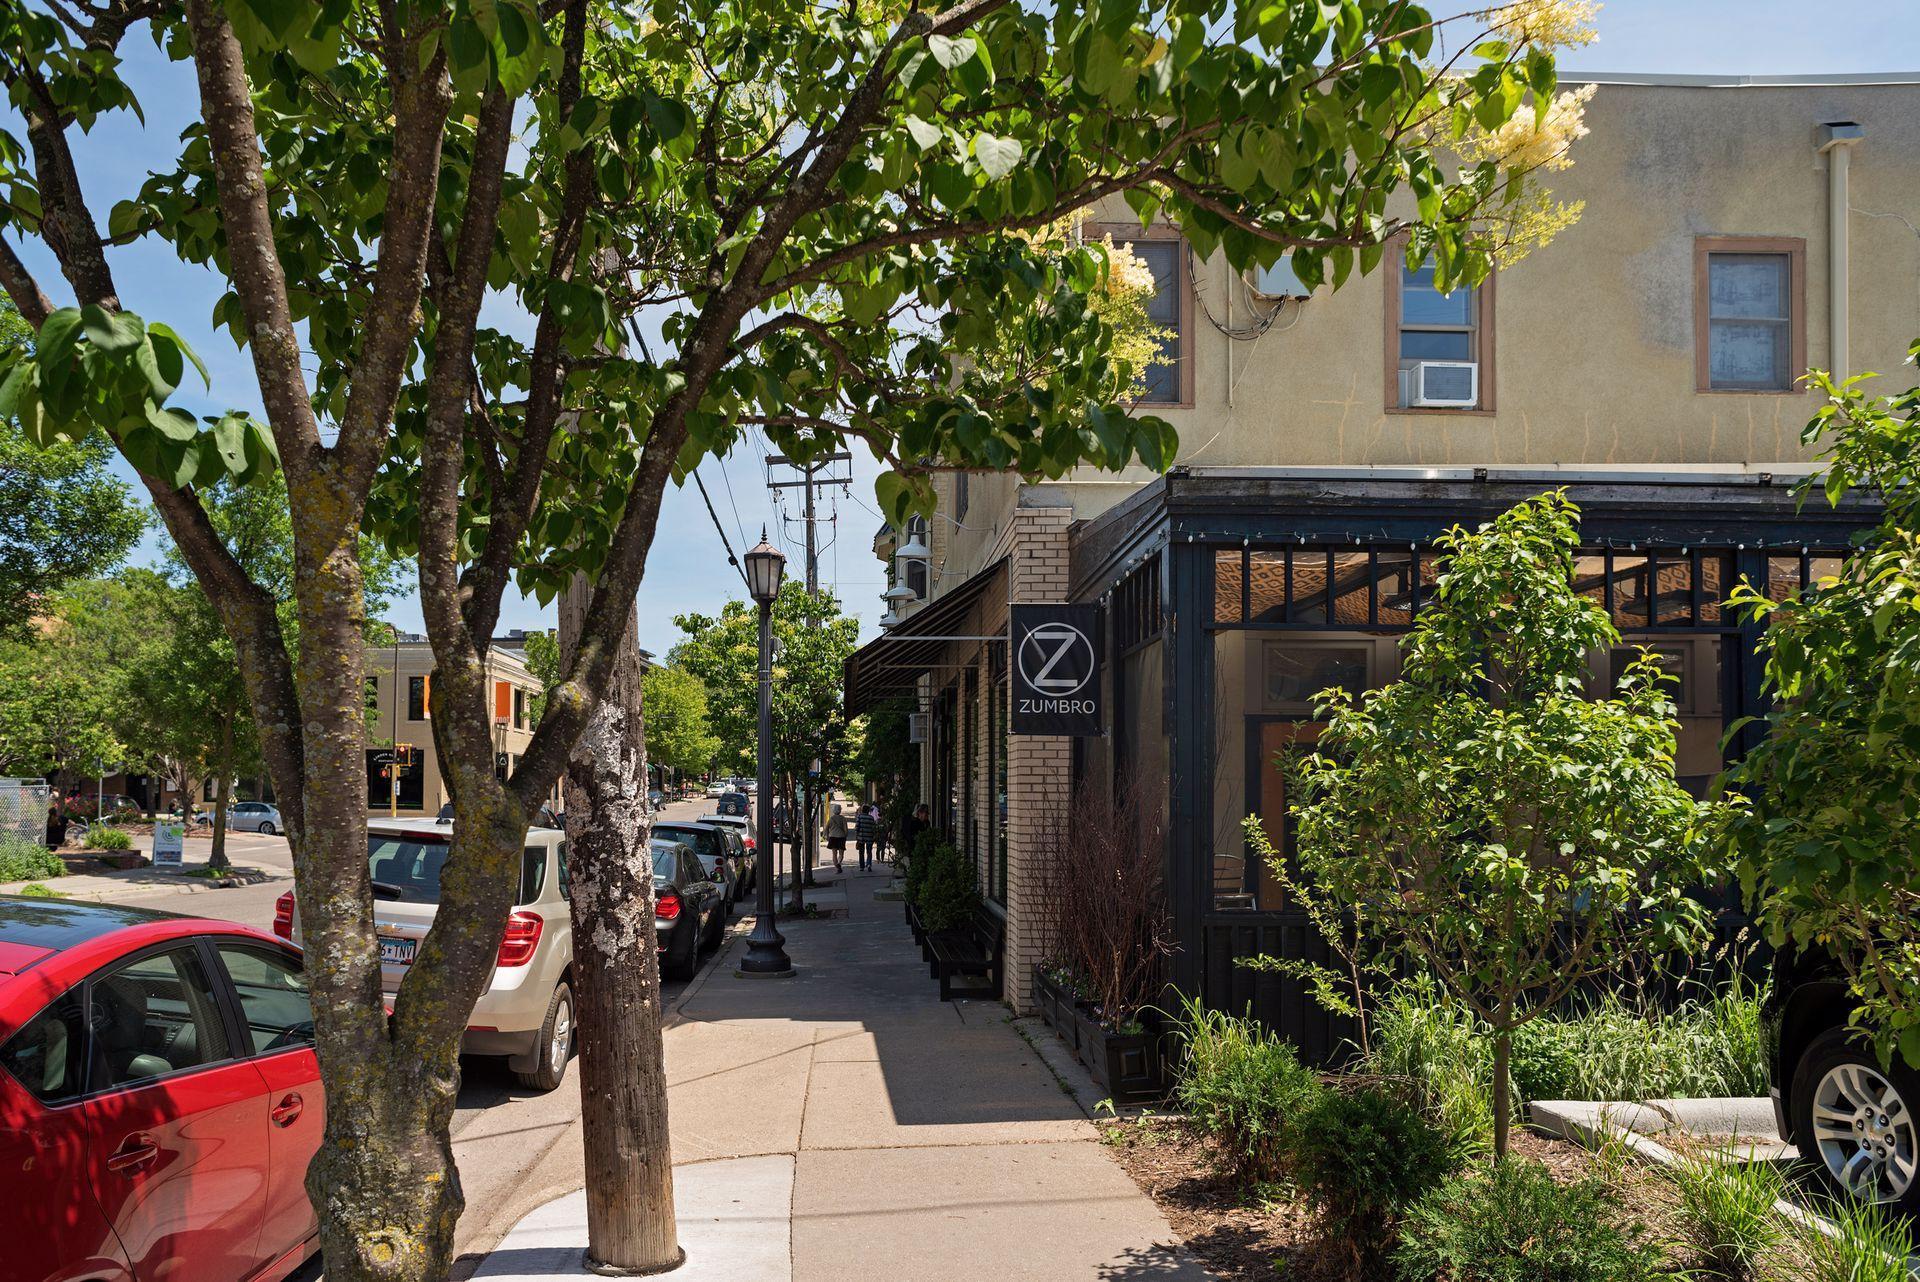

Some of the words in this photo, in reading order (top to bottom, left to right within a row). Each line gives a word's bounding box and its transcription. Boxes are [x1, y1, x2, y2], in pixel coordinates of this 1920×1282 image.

[1034, 632, 1078, 687] Z
[1019, 700, 1096, 714] ZUMBRO
[394, 945, 412, 958] TNV
